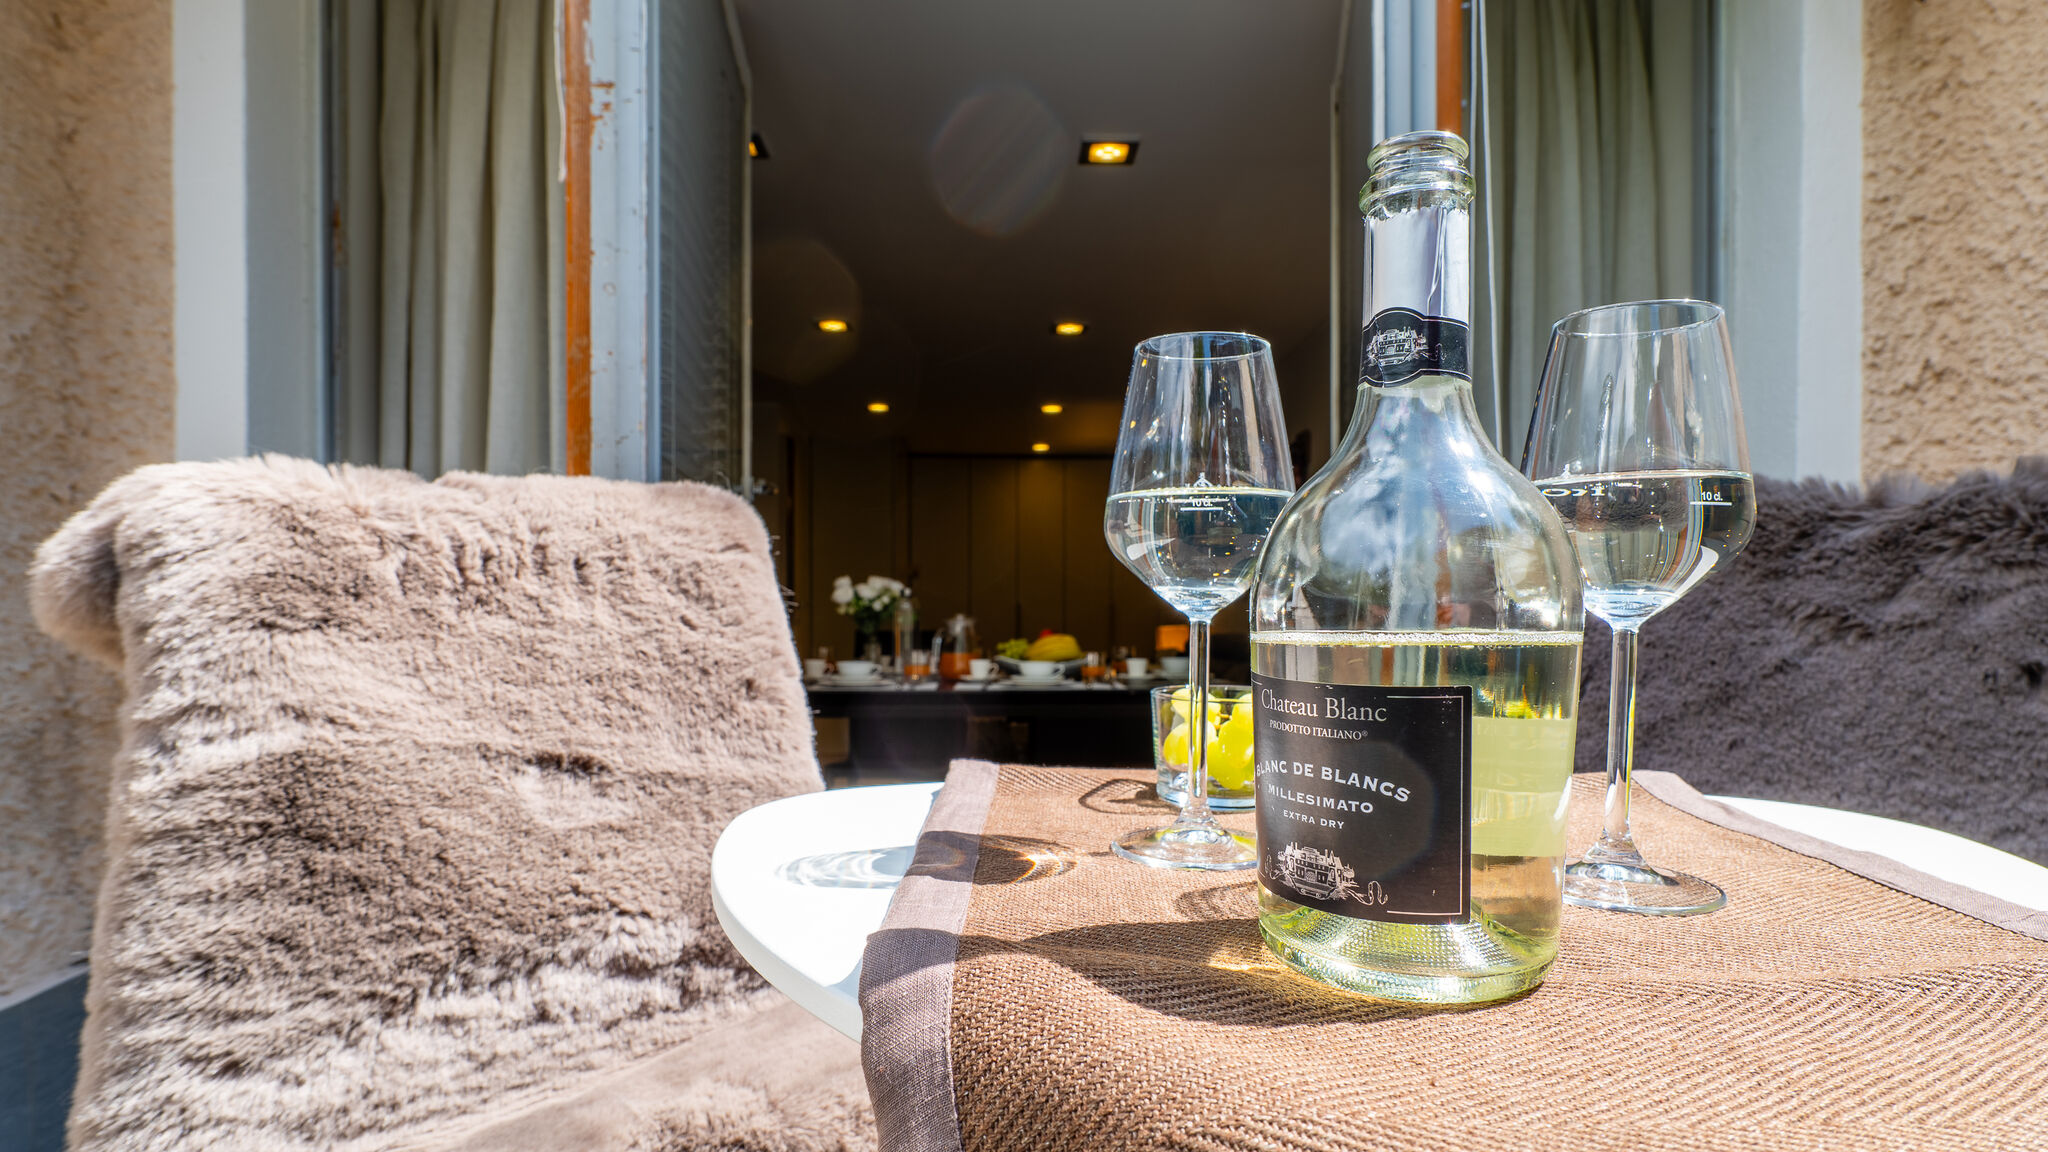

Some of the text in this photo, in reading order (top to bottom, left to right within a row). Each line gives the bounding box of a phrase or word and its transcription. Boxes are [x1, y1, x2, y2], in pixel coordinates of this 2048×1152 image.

[1701, 491, 1712, 501] 10
[1261, 688, 1387, 722] Chateau Blanc
[1269, 719, 1311, 736] PRODOTTO
[1256, 759, 1412, 802] BLANC DE BLANCS
[1268, 783, 1374, 813] MILLESIMATO
[1283, 809, 1345, 830] EXTRA DRY
